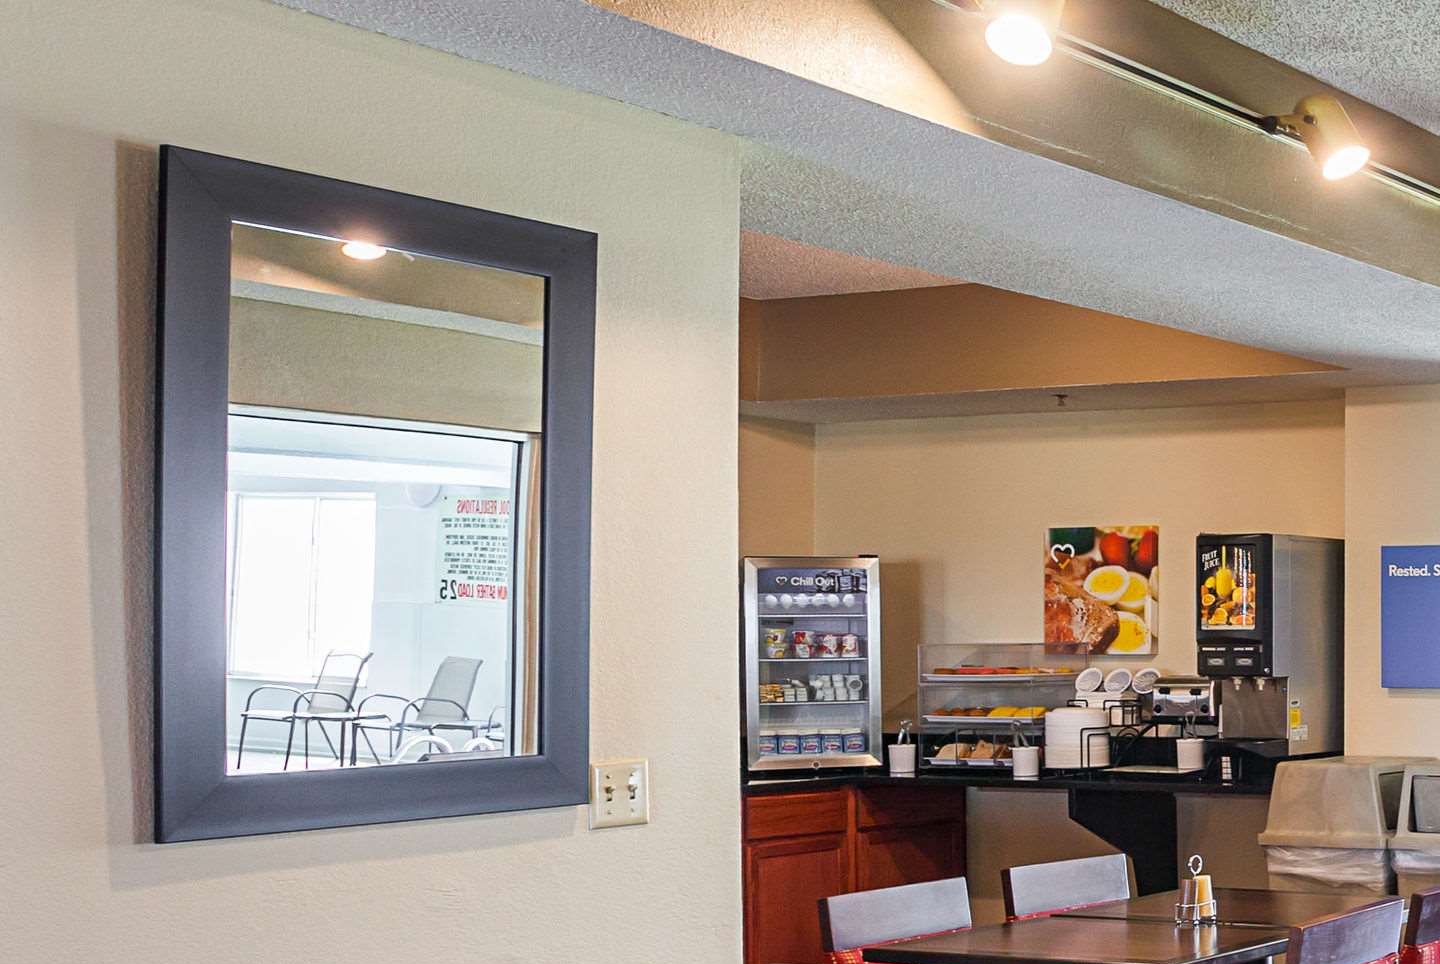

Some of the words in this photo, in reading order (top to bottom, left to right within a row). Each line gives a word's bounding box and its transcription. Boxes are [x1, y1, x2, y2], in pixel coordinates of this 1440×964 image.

[1388, 564, 1431, 577] Rested.
[790, 576, 814, 586] Chill
[815, 576, 835, 587] Out
